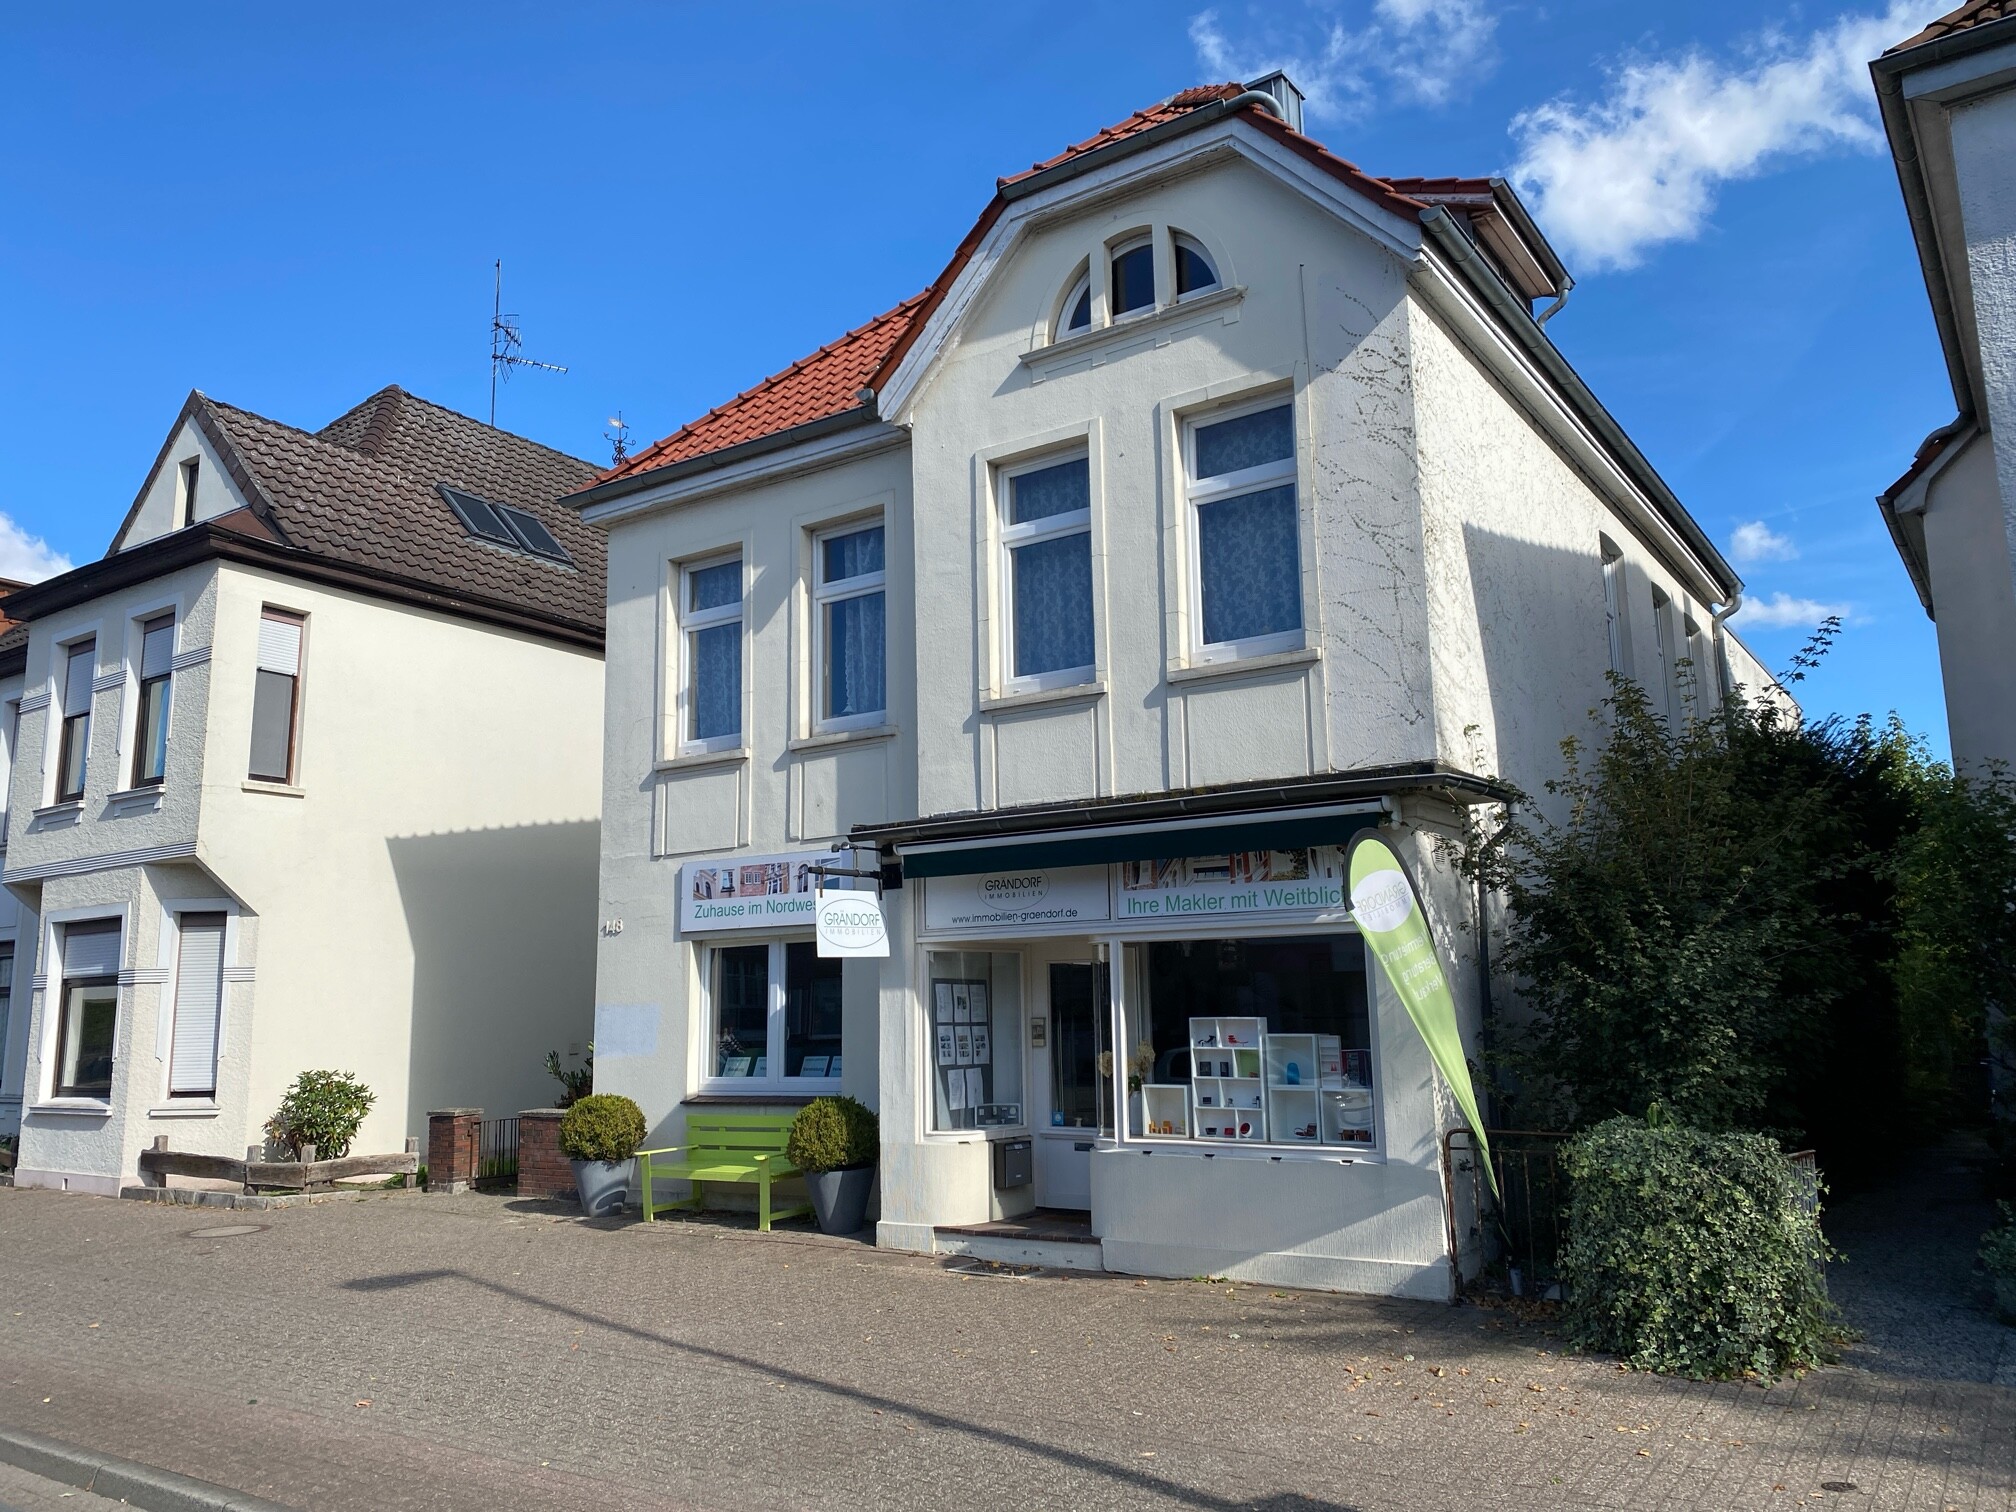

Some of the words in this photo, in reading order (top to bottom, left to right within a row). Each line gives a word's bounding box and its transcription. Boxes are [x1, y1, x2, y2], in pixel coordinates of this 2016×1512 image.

[985, 876, 1042, 891] GRÄNDORF
[984, 890, 1043, 900] IMMOBILIEN
[1127, 897, 1159, 914] Ihre
[1165, 893, 1225, 912] Makler
[1231, 890, 1259, 909] mit
[694, 903, 744, 919] Zuhause
[748, 901, 762, 915] im
[951, 908, 1078, 923] www.immobilien-graendorf.de
[824, 910, 881, 926] GRÄNDORF
[605, 919, 624, 934] 148
[825, 928, 881, 936] IMMOBILIEN
